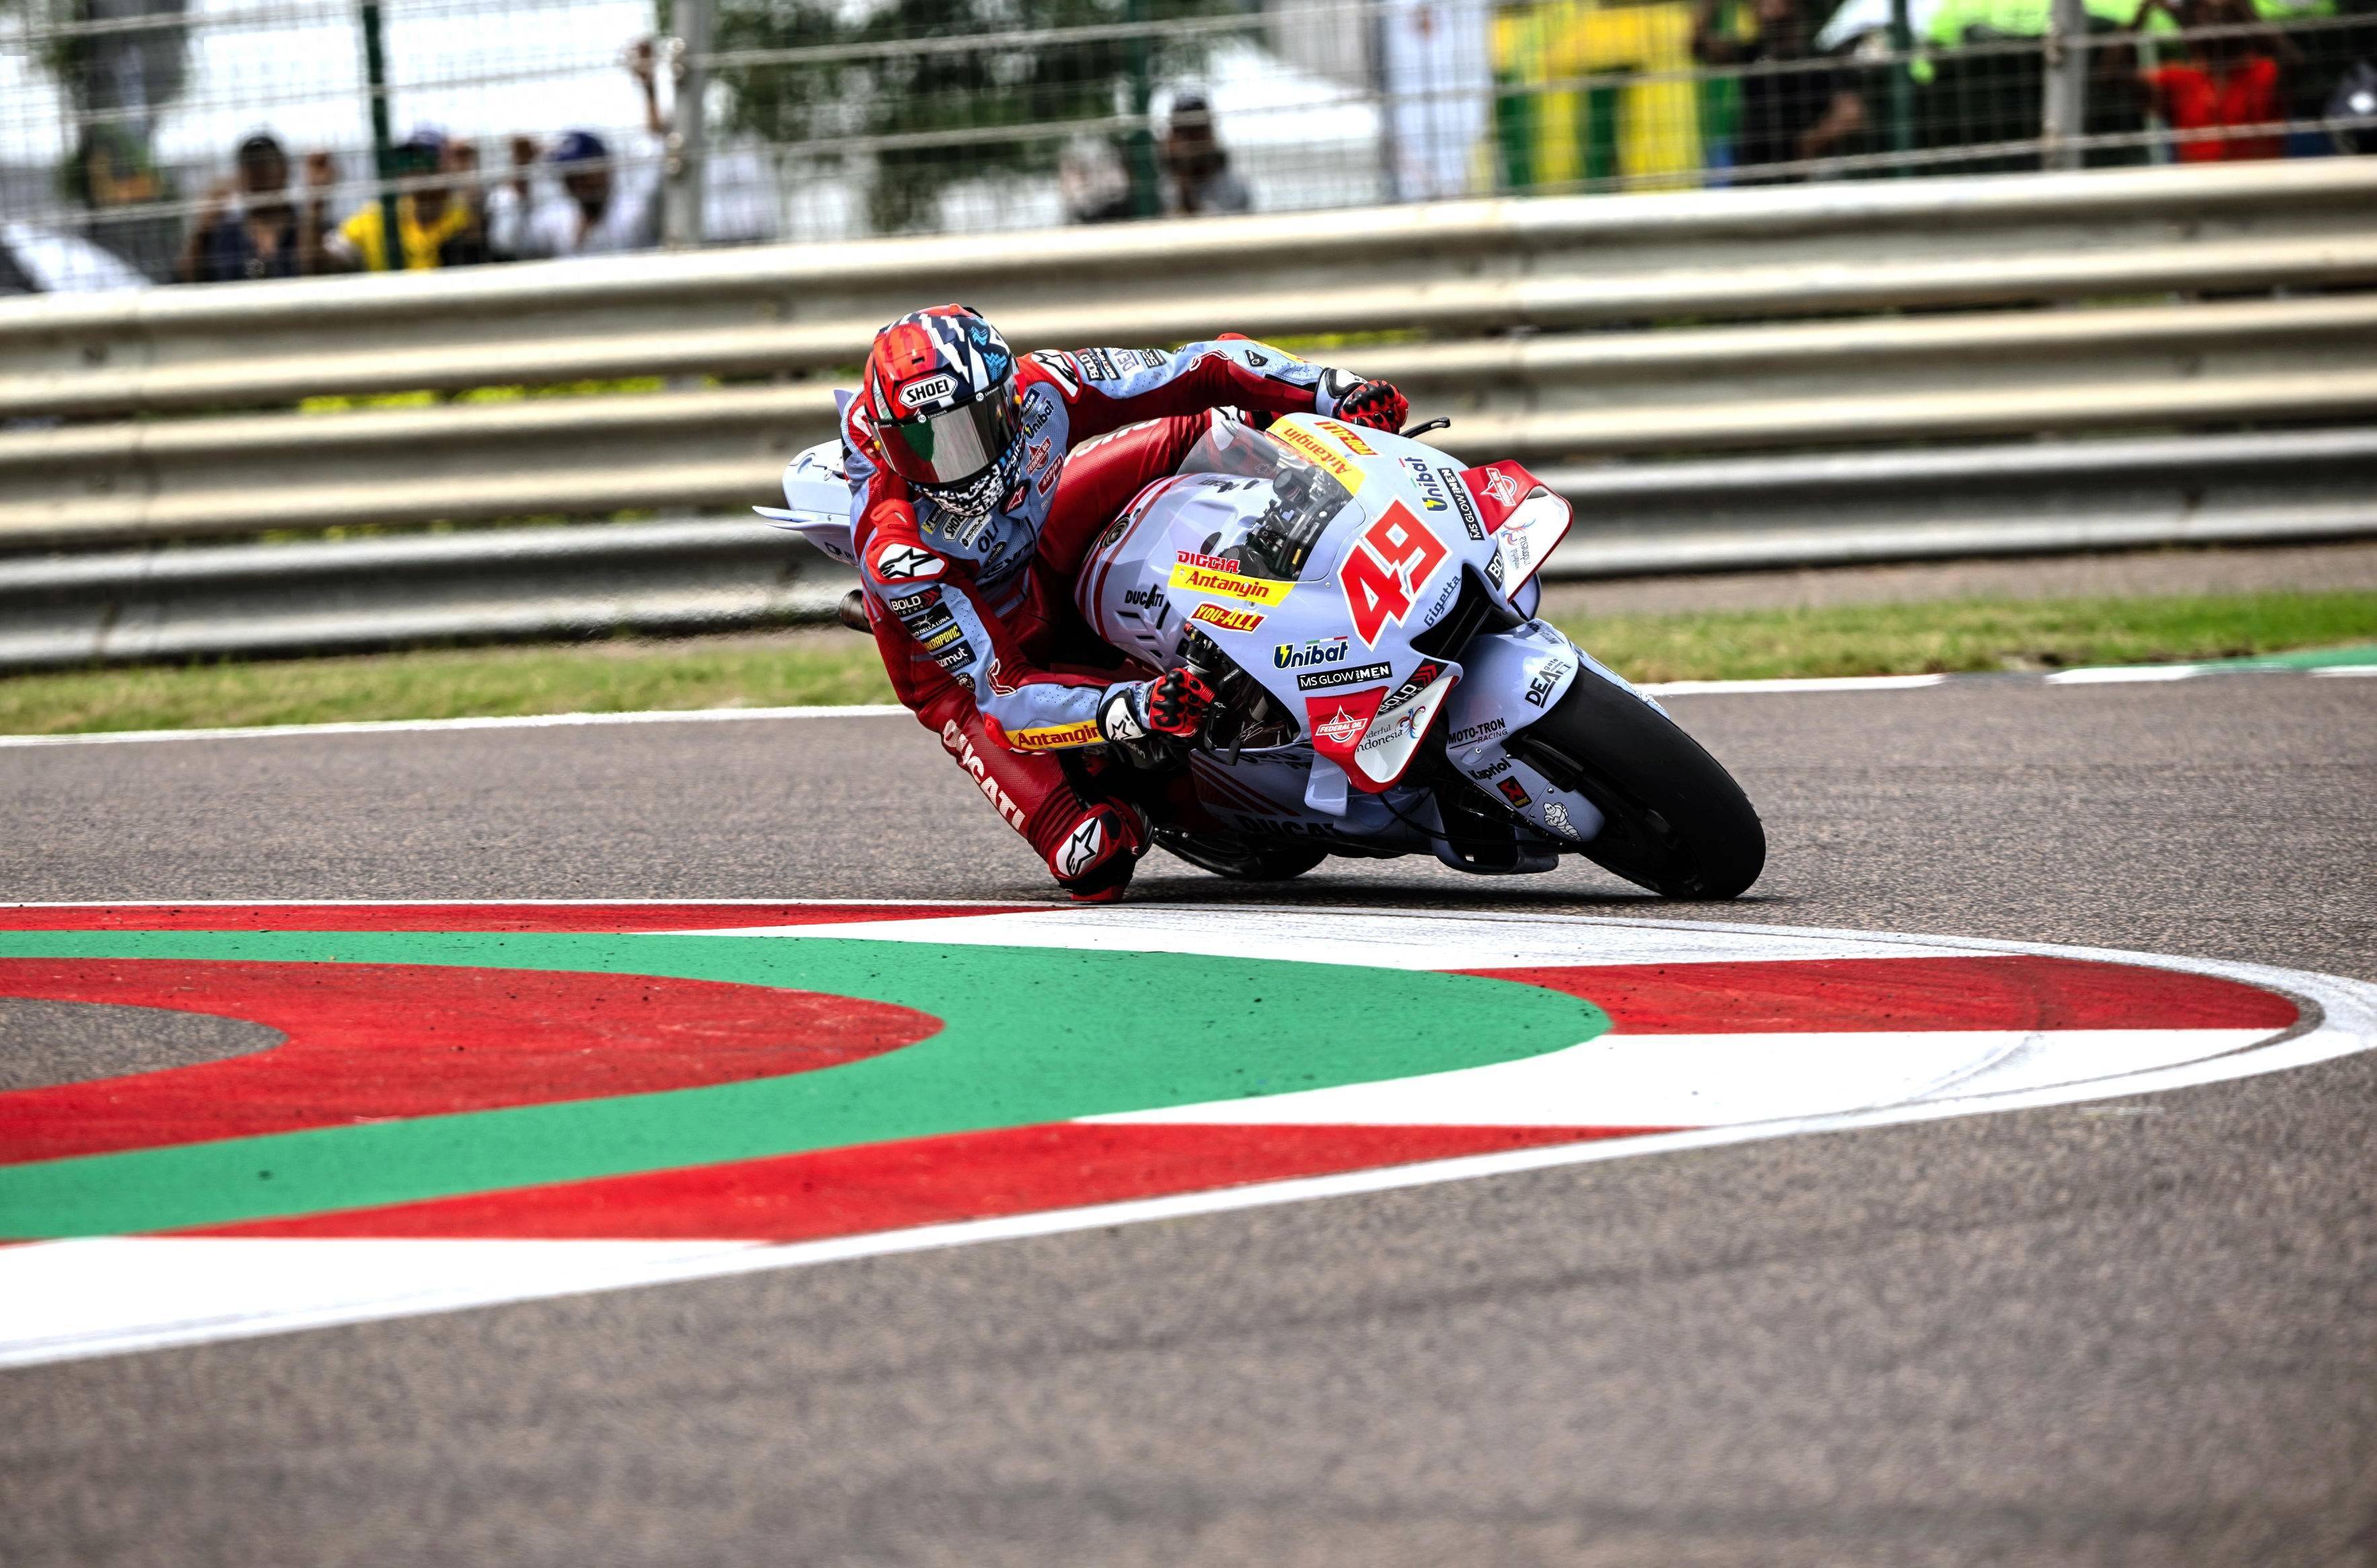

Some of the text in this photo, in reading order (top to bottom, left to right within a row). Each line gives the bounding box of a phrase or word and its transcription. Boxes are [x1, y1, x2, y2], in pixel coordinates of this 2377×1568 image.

[907, 379, 950, 403] SHOEI
[1025, 399, 1055, 439] Unibat
[1027, 441, 1050, 472] FEDERAL OIL
[1283, 427, 1351, 474] Antangin
[1404, 456, 1448, 511] Unibat
[1441, 469, 1460, 492] MEN
[1455, 493, 1475, 523] GLOW
[1468, 524, 1482, 538] MS
[1177, 550, 1240, 574] DIGGIA
[1337, 494, 1454, 653] 49
[1125, 583, 1164, 610] DUCATI
[1185, 571, 1269, 598] Antangin
[891, 596, 921, 610] BOLD
[1423, 575, 1461, 627] Gigetta
[919, 615, 950, 634] DELLA LUNA
[1196, 604, 1260, 631] YOU-ALL
[1274, 641, 1349, 669] Unibat
[1544, 658, 1559, 672] gate
[1300, 676, 1317, 687] MS
[1319, 672, 1353, 684] GLOW
[1359, 666, 1389, 679] MEN
[1380, 684, 1417, 711] BOLD
[1320, 725, 1350, 733] FEDERAL
[1448, 717, 1505, 744] MOTO-TRON
[1477, 728, 1508, 744] RACING
[942, 719, 1025, 830] DUCATI
[1468, 758, 1512, 780] Kapriol
